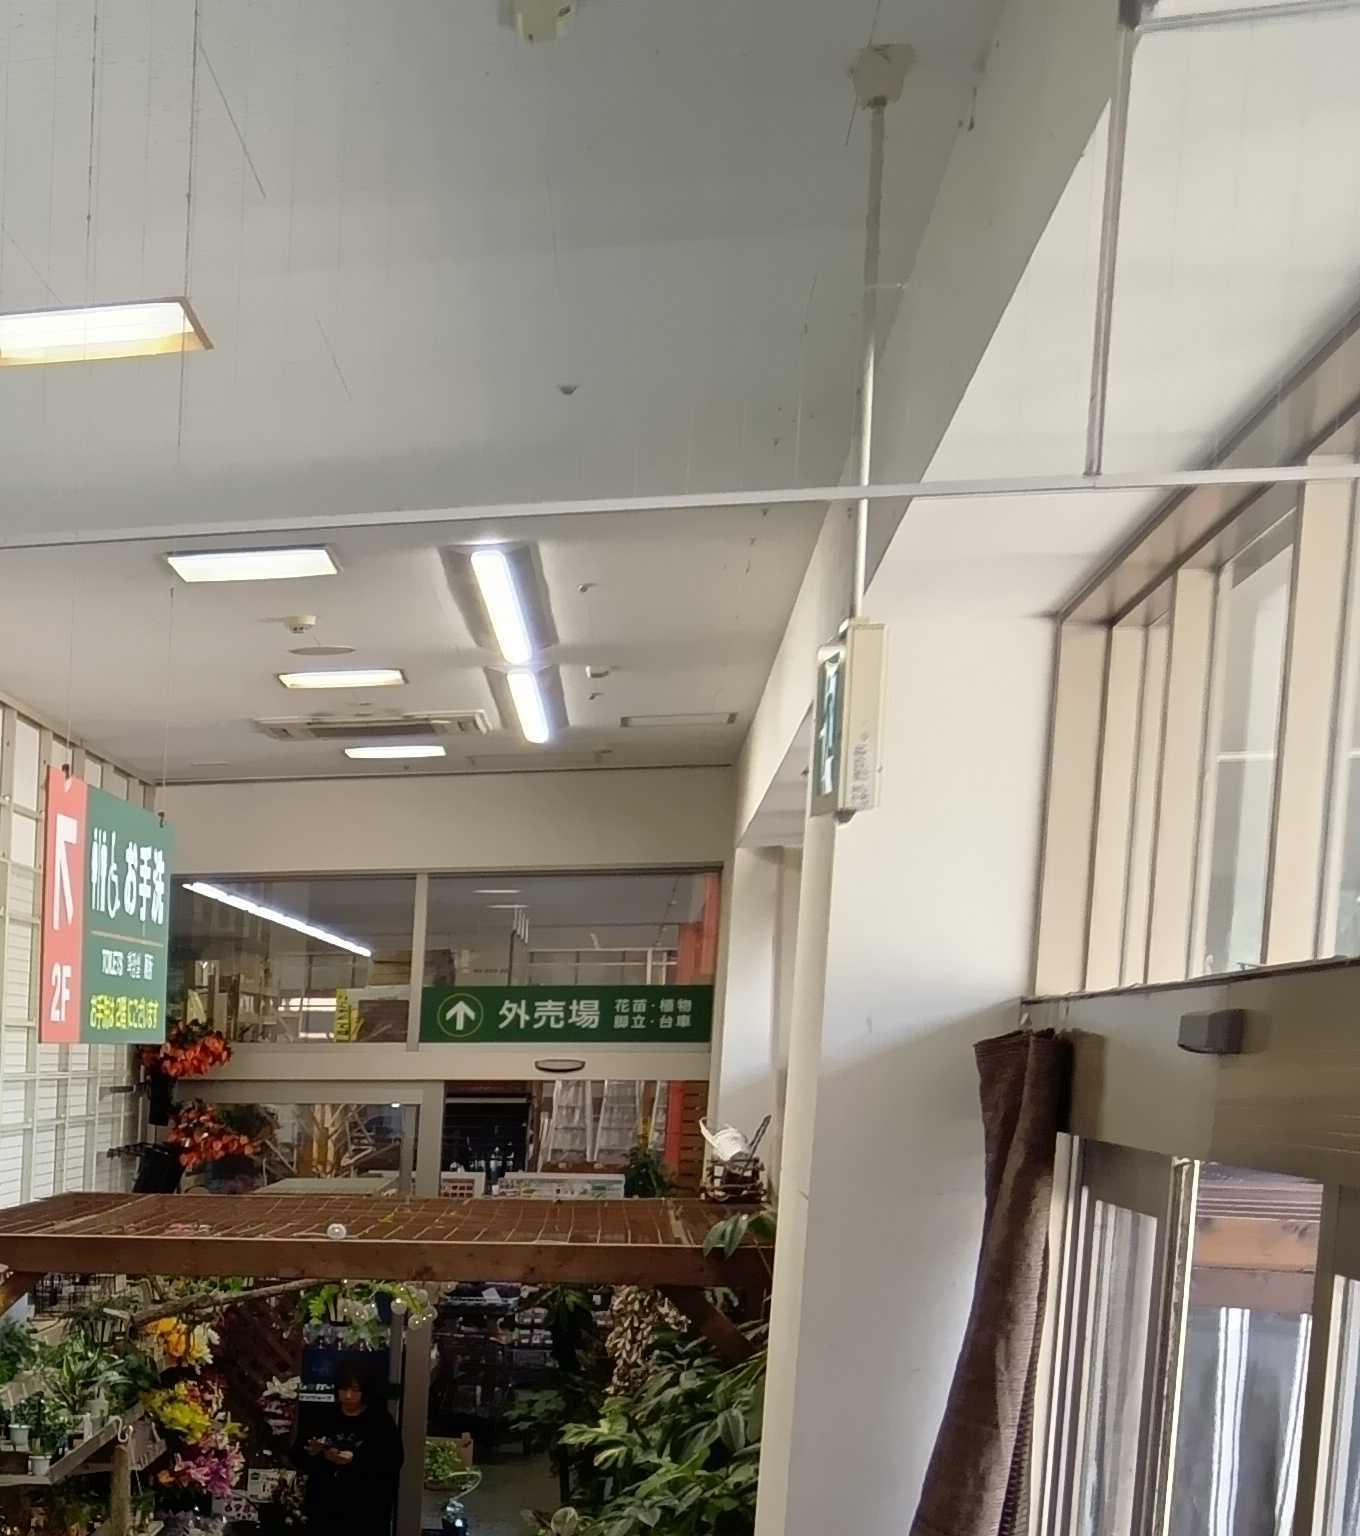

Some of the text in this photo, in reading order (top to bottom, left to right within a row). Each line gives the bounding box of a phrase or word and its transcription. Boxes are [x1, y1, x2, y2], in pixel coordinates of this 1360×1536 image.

[49, 962, 72, 1023] 2F
[497, 999, 601, 1030] 外売場
[613, 997, 693, 1014] 花苗・植物
[613, 1014, 693, 1029] 脚立・台車
